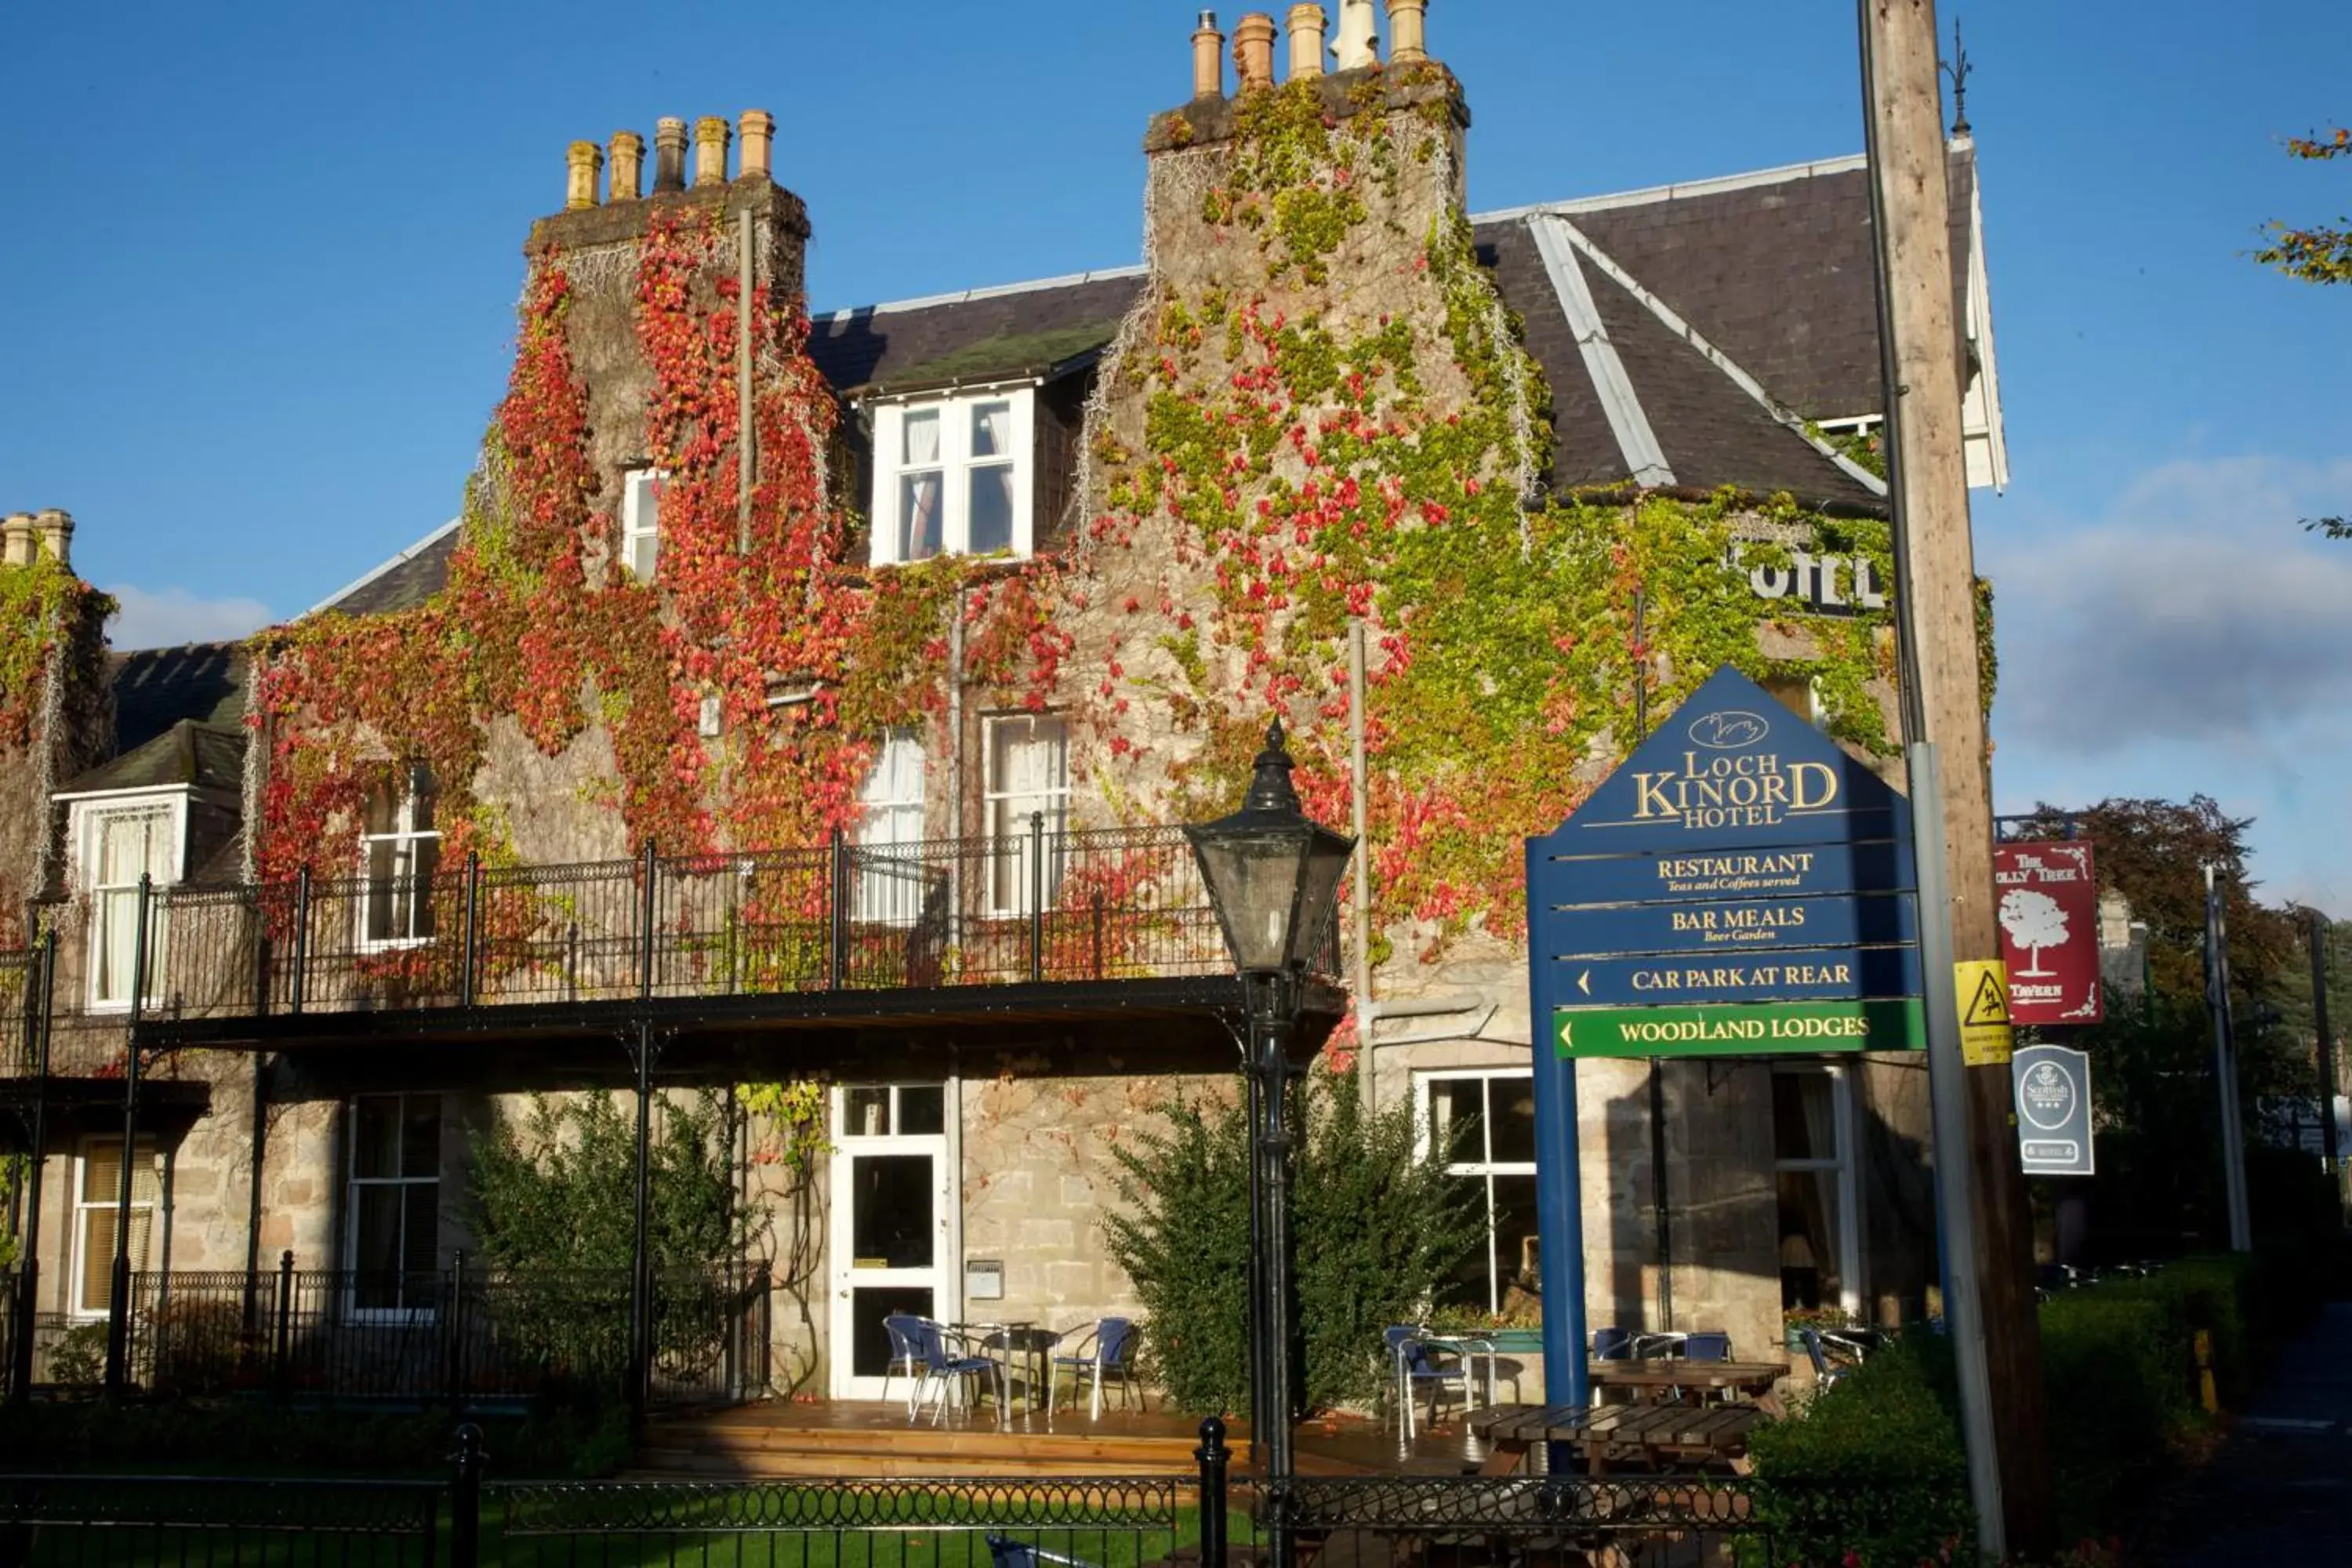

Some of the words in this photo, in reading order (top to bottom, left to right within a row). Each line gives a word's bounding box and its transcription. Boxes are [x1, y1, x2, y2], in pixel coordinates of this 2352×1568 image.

[1682, 751, 1777, 779] LOCH
[1632, 762, 1838, 818] KINORD
[1683, 804, 1782, 829] HOTEL
[1657, 853, 1814, 879] RESTAURANT
[2014, 854, 2042, 869] THE
[1668, 880, 1693, 891] Teas
[1694, 877, 1719, 890] and
[1719, 877, 1761, 891] Coffees
[1762, 873, 1801, 887] served
[1995, 869, 2031, 884] OLLY
[2035, 867, 2077, 882] TREE
[1672, 910, 1718, 931] BAR
[1725, 906, 1805, 928] MEALS
[1704, 931, 1732, 942] Beer
[1732, 928, 1777, 941] Garden
[1632, 971, 1681, 990] CAR
[1686, 967, 1746, 989] PARK
[1749, 967, 1780, 986] AT
[1784, 964, 1851, 985] REAR
[2009, 984, 2063, 997] TAVERN
[1618, 1020, 1765, 1042] WOODLAND
[1771, 1016, 1871, 1039] LODGES
